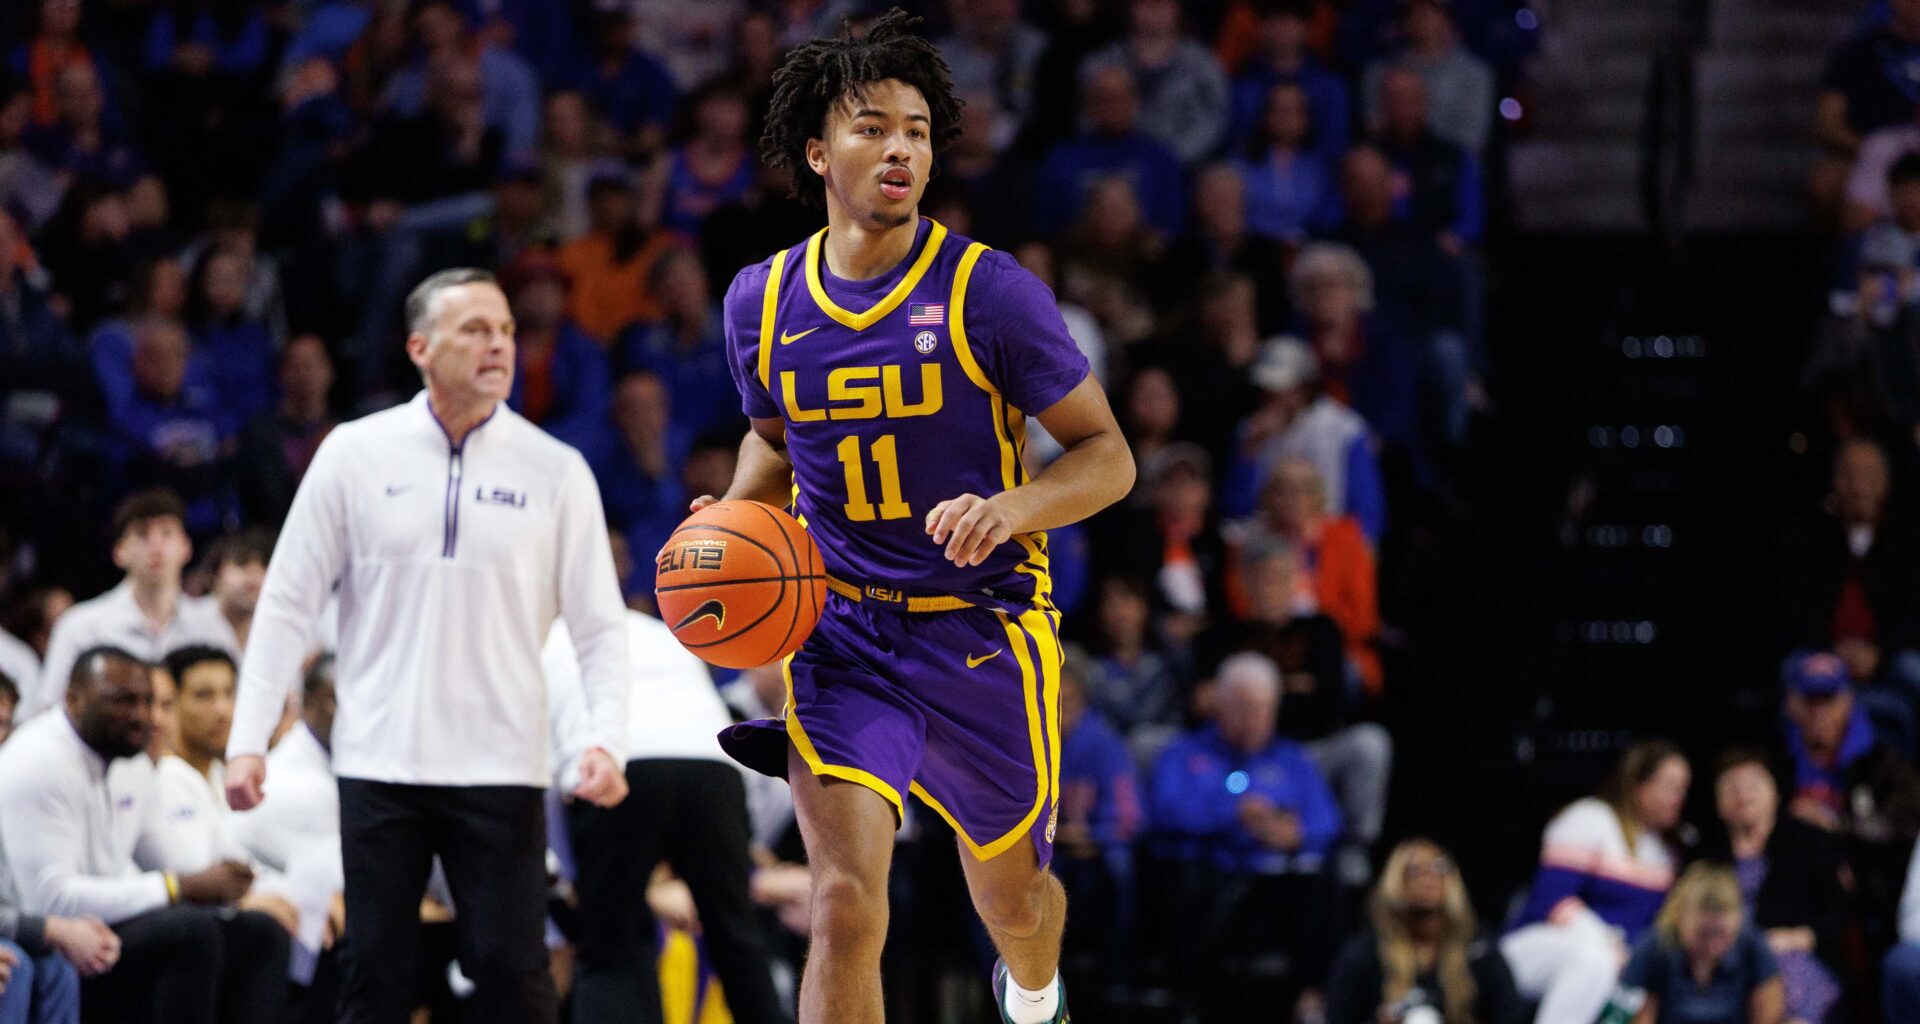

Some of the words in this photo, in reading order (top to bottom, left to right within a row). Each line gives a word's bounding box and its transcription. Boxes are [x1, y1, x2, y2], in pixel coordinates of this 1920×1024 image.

[916, 332, 936, 352] SEC
[779, 363, 943, 422] LSU
[836, 434, 912, 522] 11
[475, 486, 527, 508] LSU
[658, 547, 724, 575] ELITE
[865, 584, 903, 603] LSU
